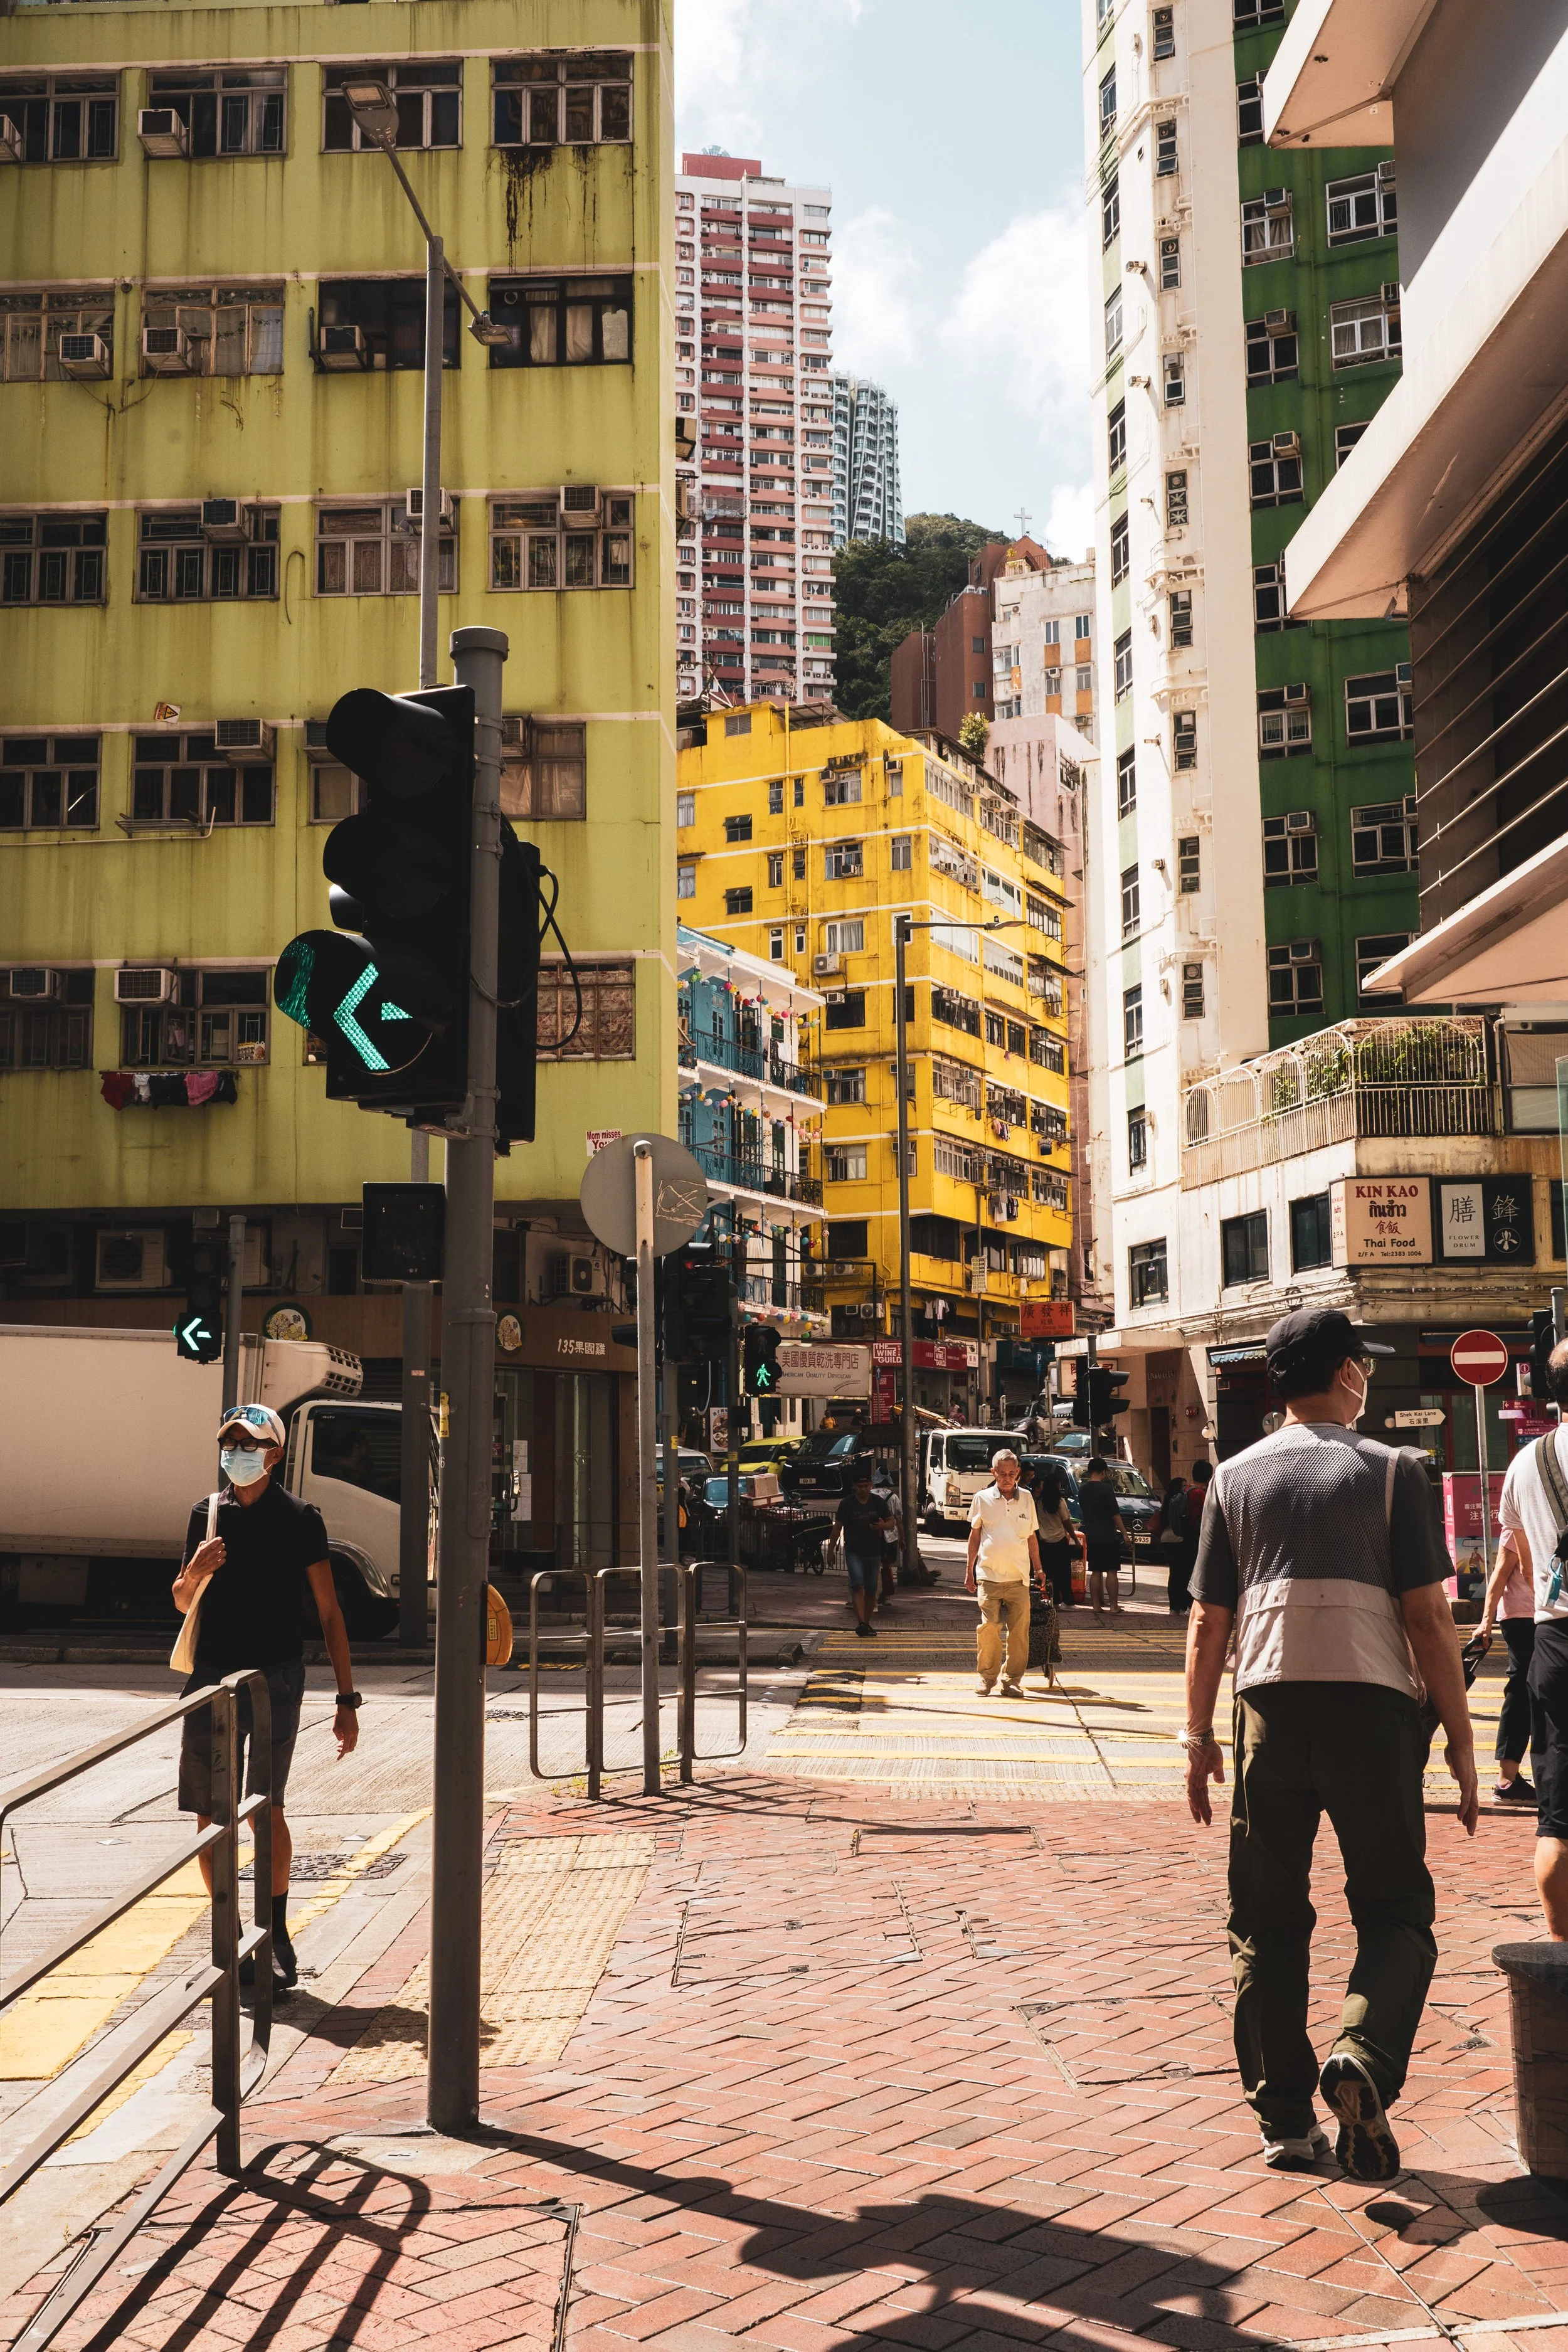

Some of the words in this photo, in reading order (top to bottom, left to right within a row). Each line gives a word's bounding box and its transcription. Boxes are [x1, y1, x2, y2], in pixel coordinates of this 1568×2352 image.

[587, 1131, 600, 1140] Mom
[601, 1130, 621, 1139] misses
[592, 1140, 610, 1150] Yo
[1355, 1185, 1382, 1198] KIN
[1386, 1185, 1419, 1197] KAO
[1369, 1199, 1407, 1217] กินข้าว
[1375, 1220, 1402, 1235] 食飯
[1364, 1238, 1386, 1248] Thai
[1391, 1237, 1416, 1248] Food
[1022, 1303, 1072, 1318] 廣發祥
[781, 1350, 859, 1369] 美國優質乾洗專門店
[1037, 1353, 1041, 1364] P
